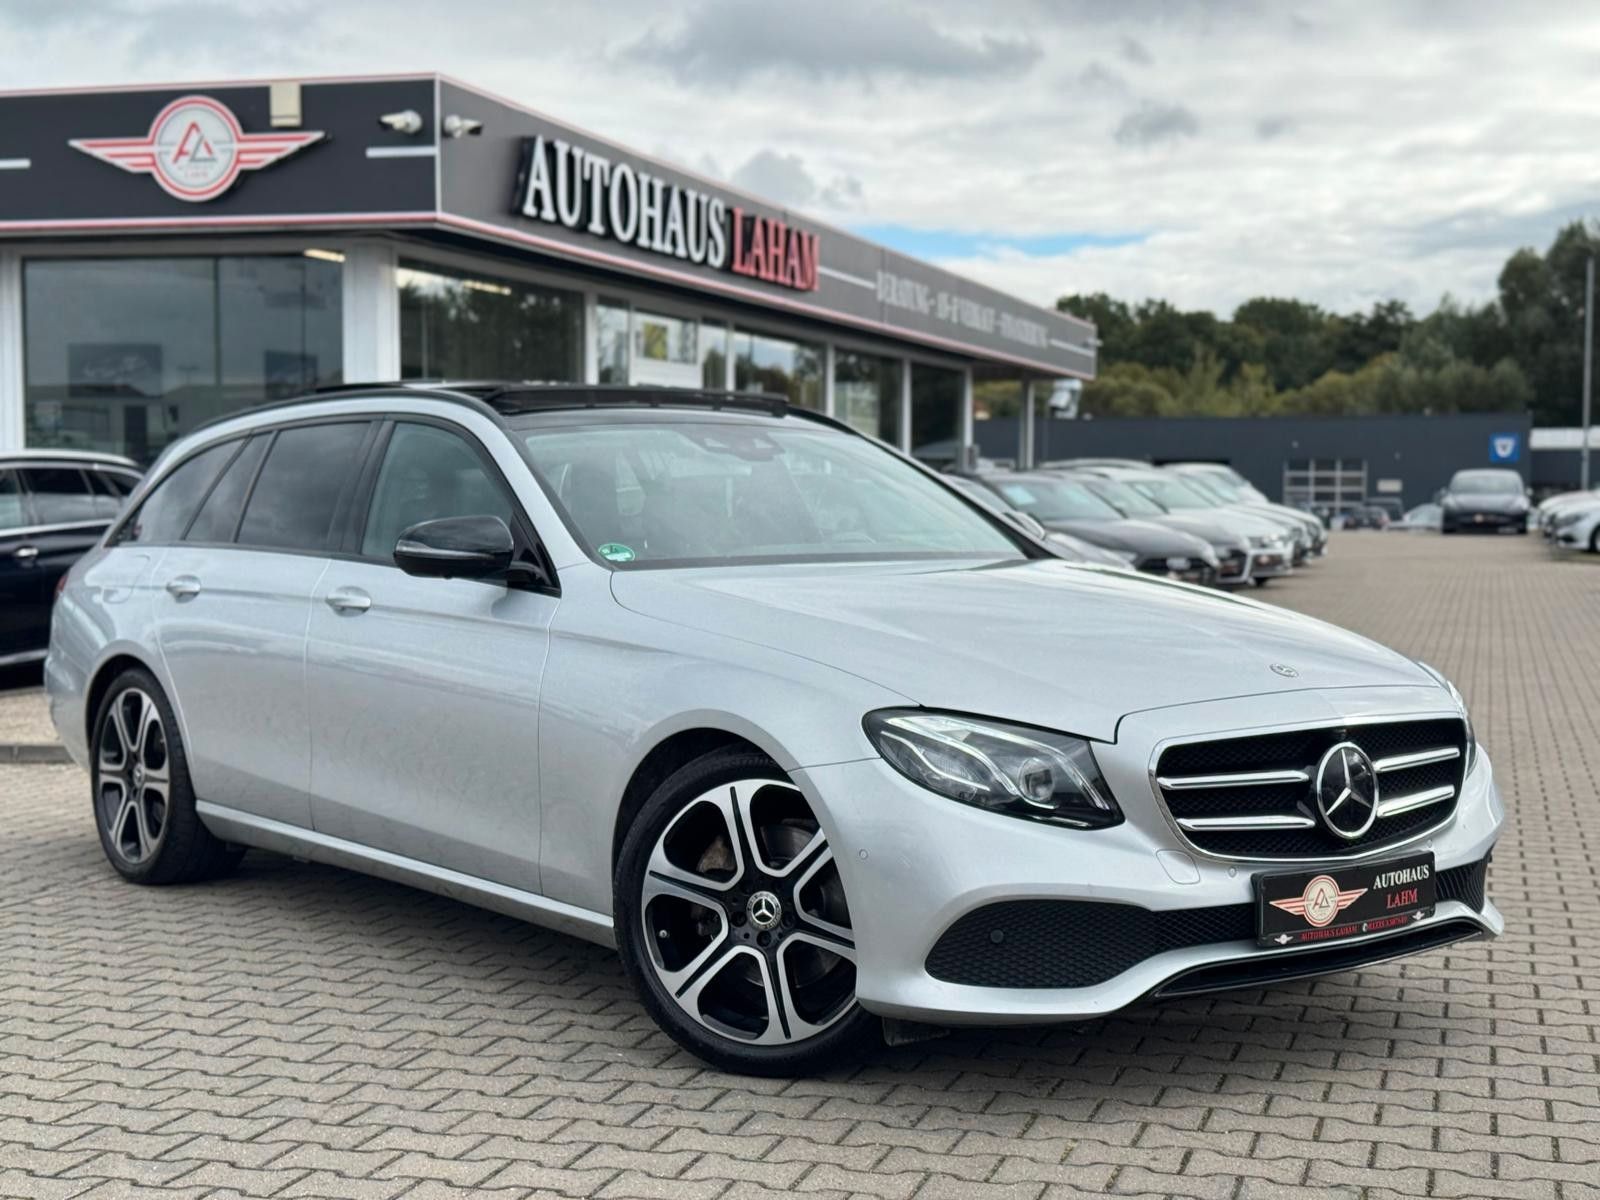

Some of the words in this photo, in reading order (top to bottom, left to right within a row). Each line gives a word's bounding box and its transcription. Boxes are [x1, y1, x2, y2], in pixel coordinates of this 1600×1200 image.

[522, 134, 727, 269] AUTOHAUS
[731, 206, 820, 292] LAHAM
[1373, 864, 1430, 890] AUTOHAUS
[1386, 888, 1418, 909] LAHM
